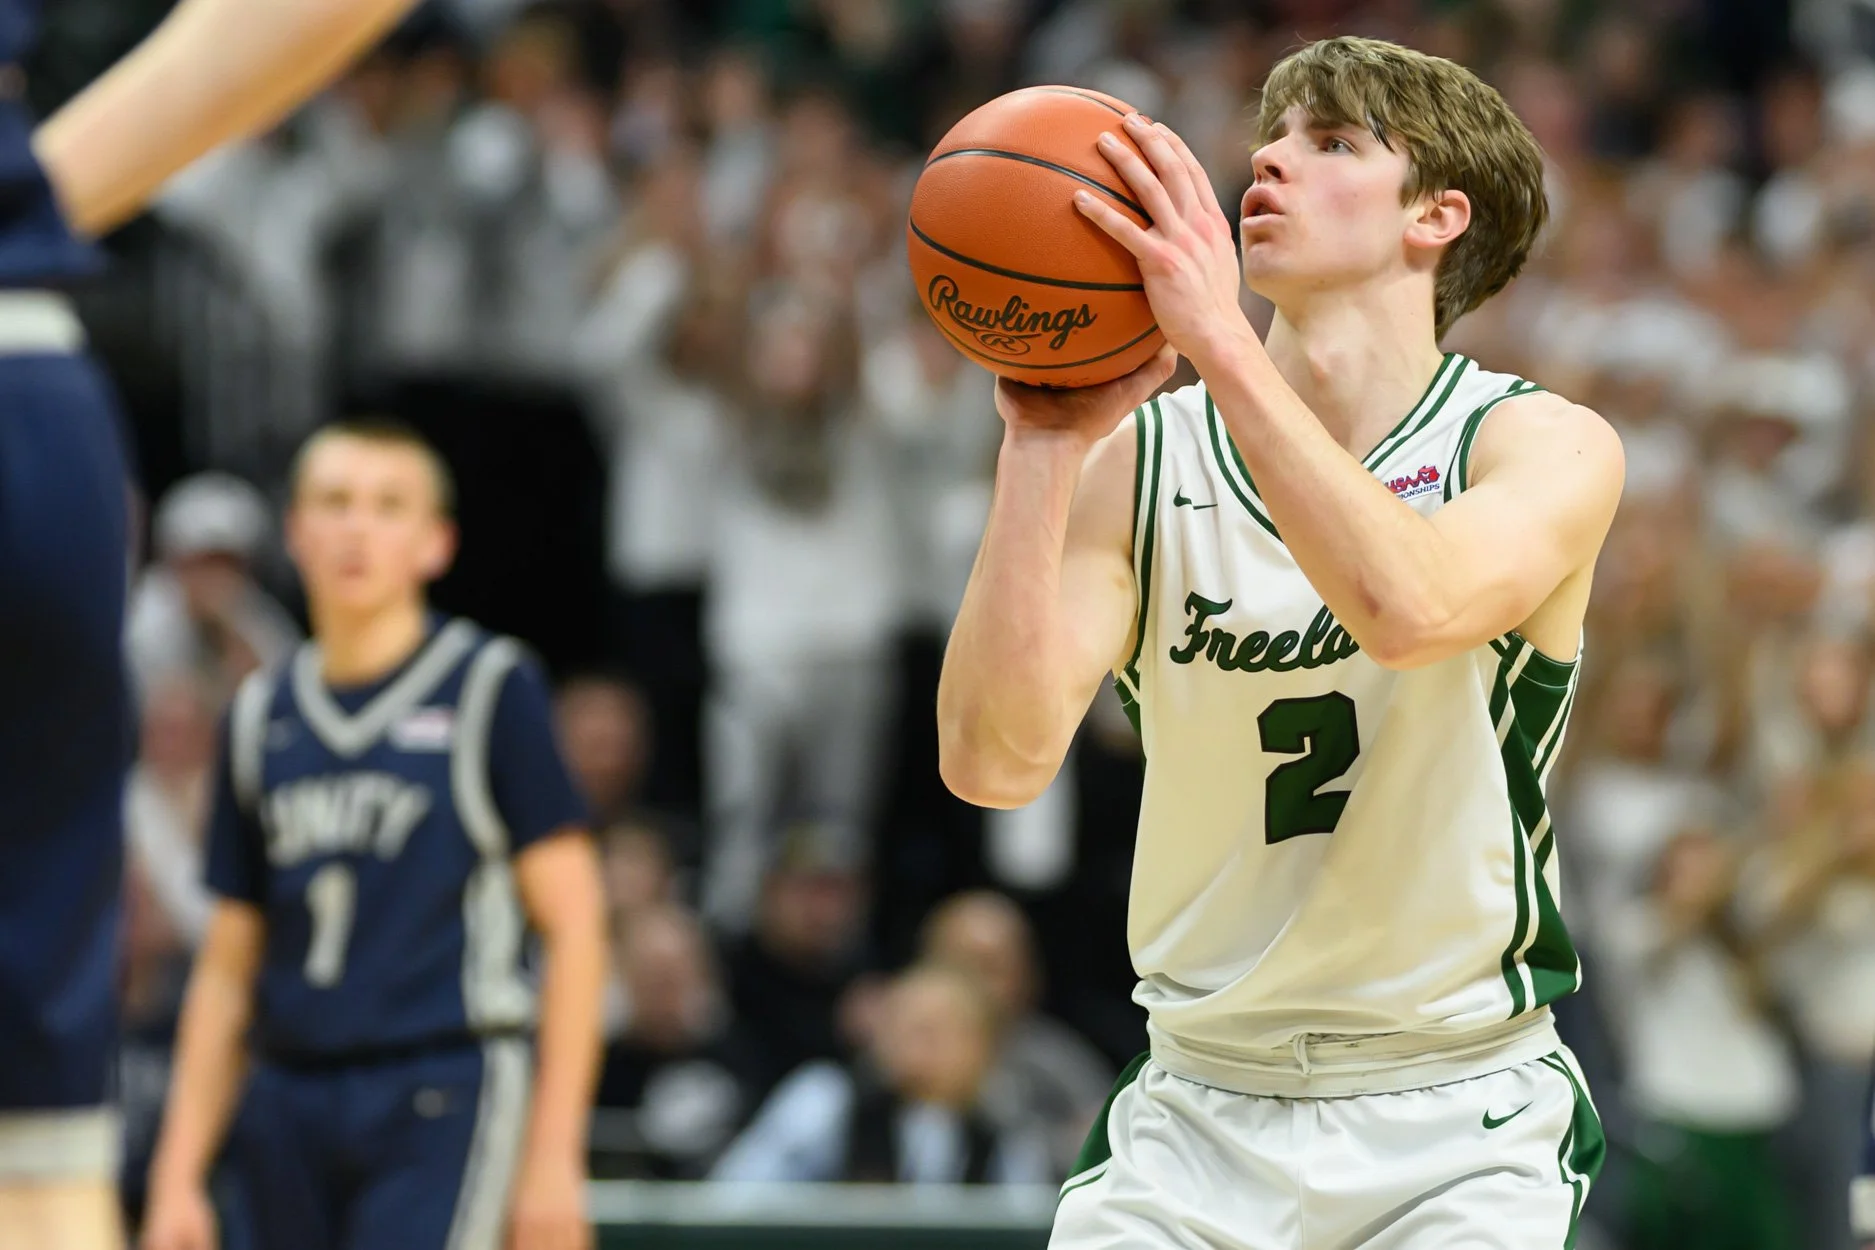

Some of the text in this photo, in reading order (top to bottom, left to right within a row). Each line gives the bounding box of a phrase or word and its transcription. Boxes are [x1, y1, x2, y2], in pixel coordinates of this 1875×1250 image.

[928, 274, 1098, 350] Rawlings
[1397, 483, 1440, 500] IONSHIPS
[1169, 591, 1360, 672] Freela
[1256, 690, 1360, 844] 2
[264, 771, 432, 867] UNITY
[303, 862, 358, 990] 1
